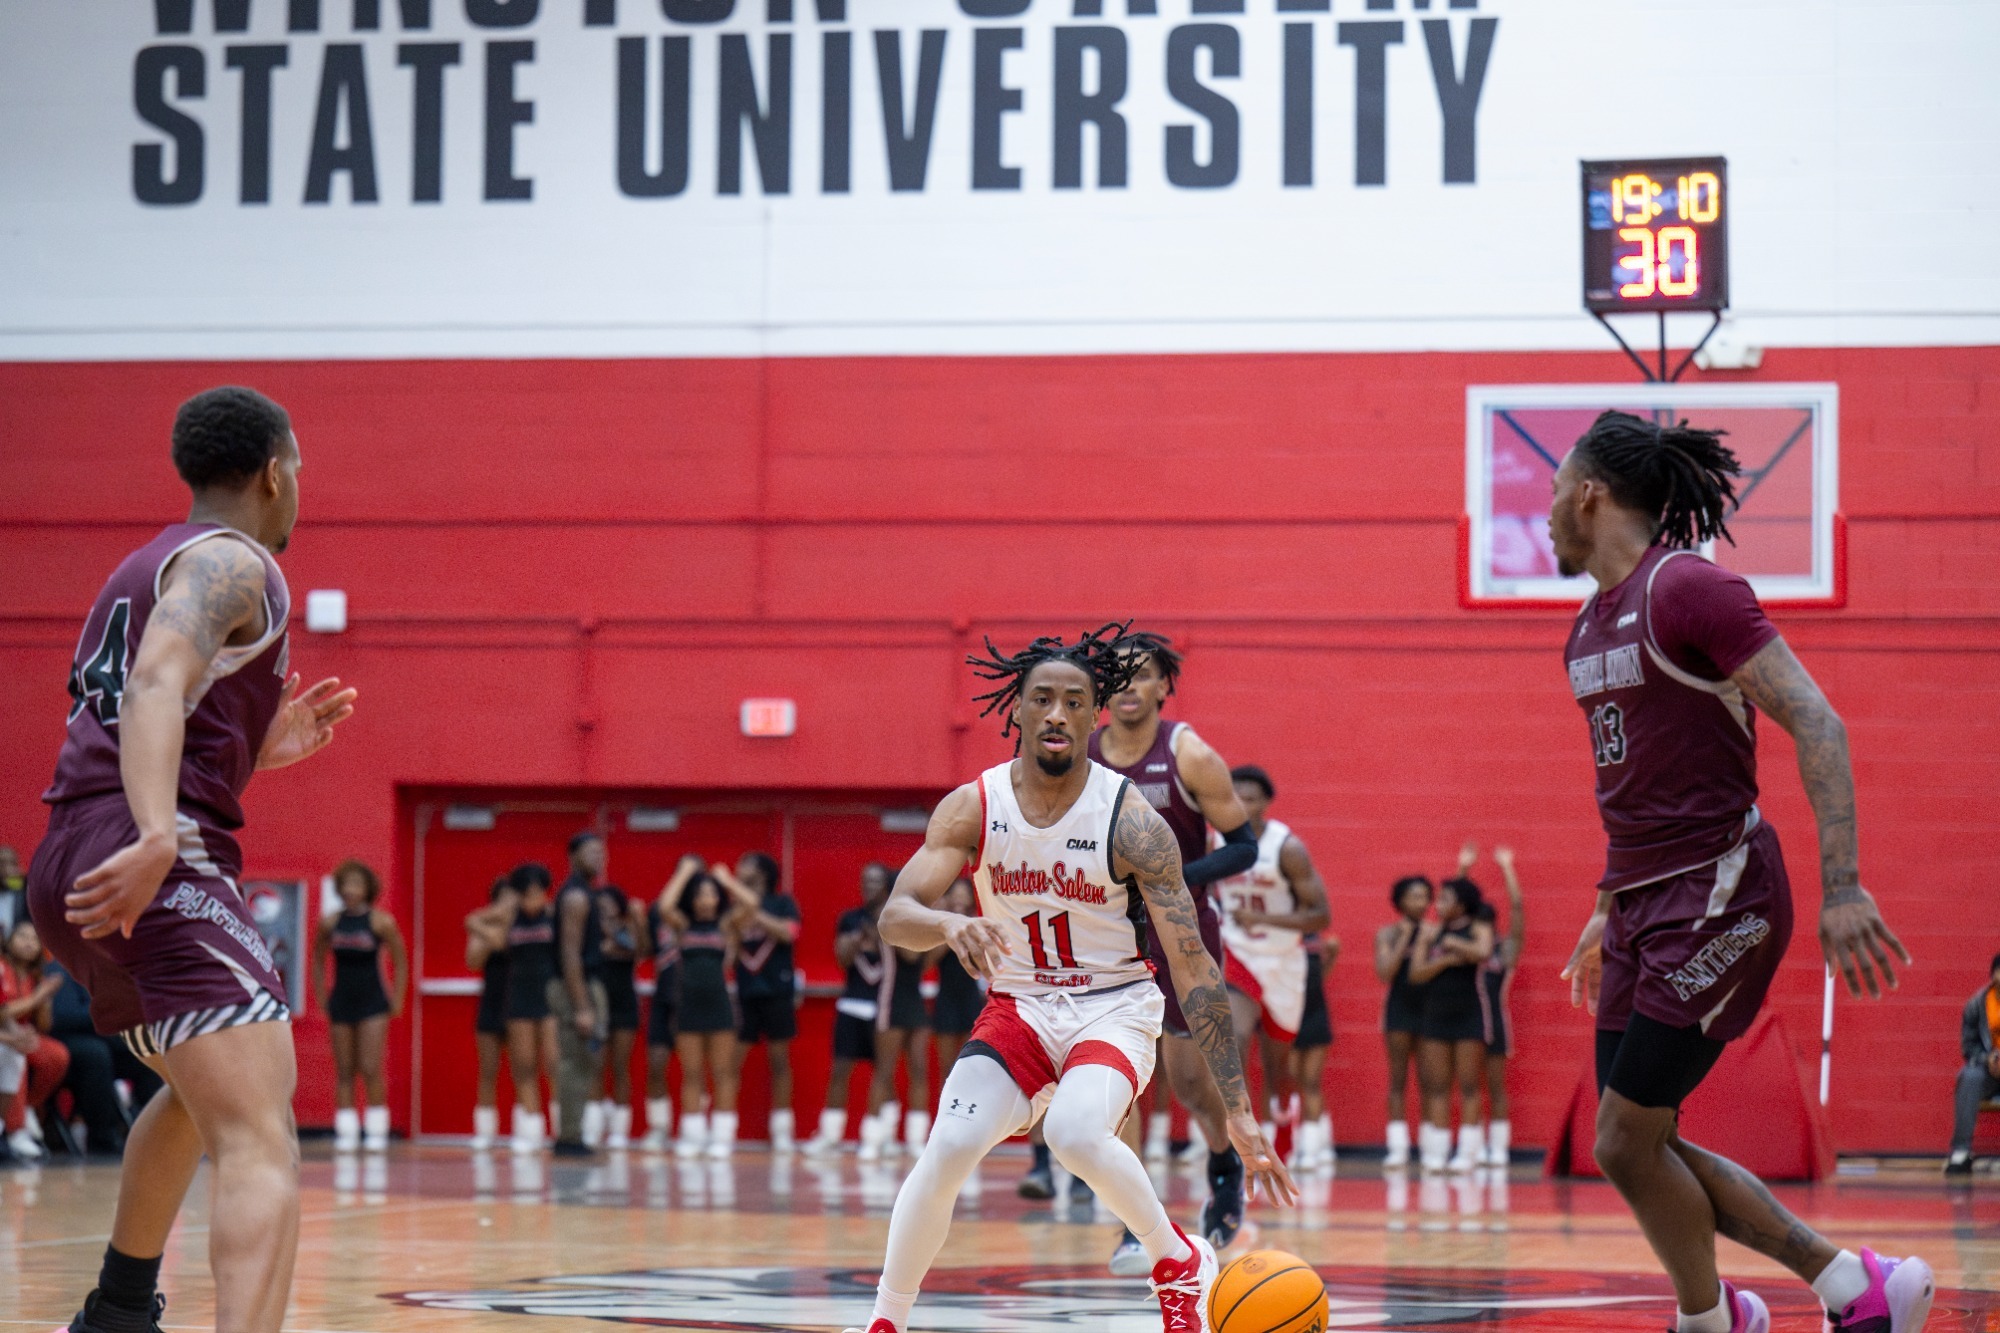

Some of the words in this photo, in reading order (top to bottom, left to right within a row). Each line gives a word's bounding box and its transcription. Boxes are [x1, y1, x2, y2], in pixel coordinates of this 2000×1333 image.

[131, 41, 537, 207] STATE
[616, 17, 1499, 199] UNIVERSITY
[1611, 173, 1718, 225] 19:10
[1618, 227, 1697, 298] 30
[1592, 702, 1626, 767] 13
[1066, 838, 1097, 852] CIAA
[988, 861, 1108, 905] Winston-Salem
[1021, 910, 1084, 970] 11
